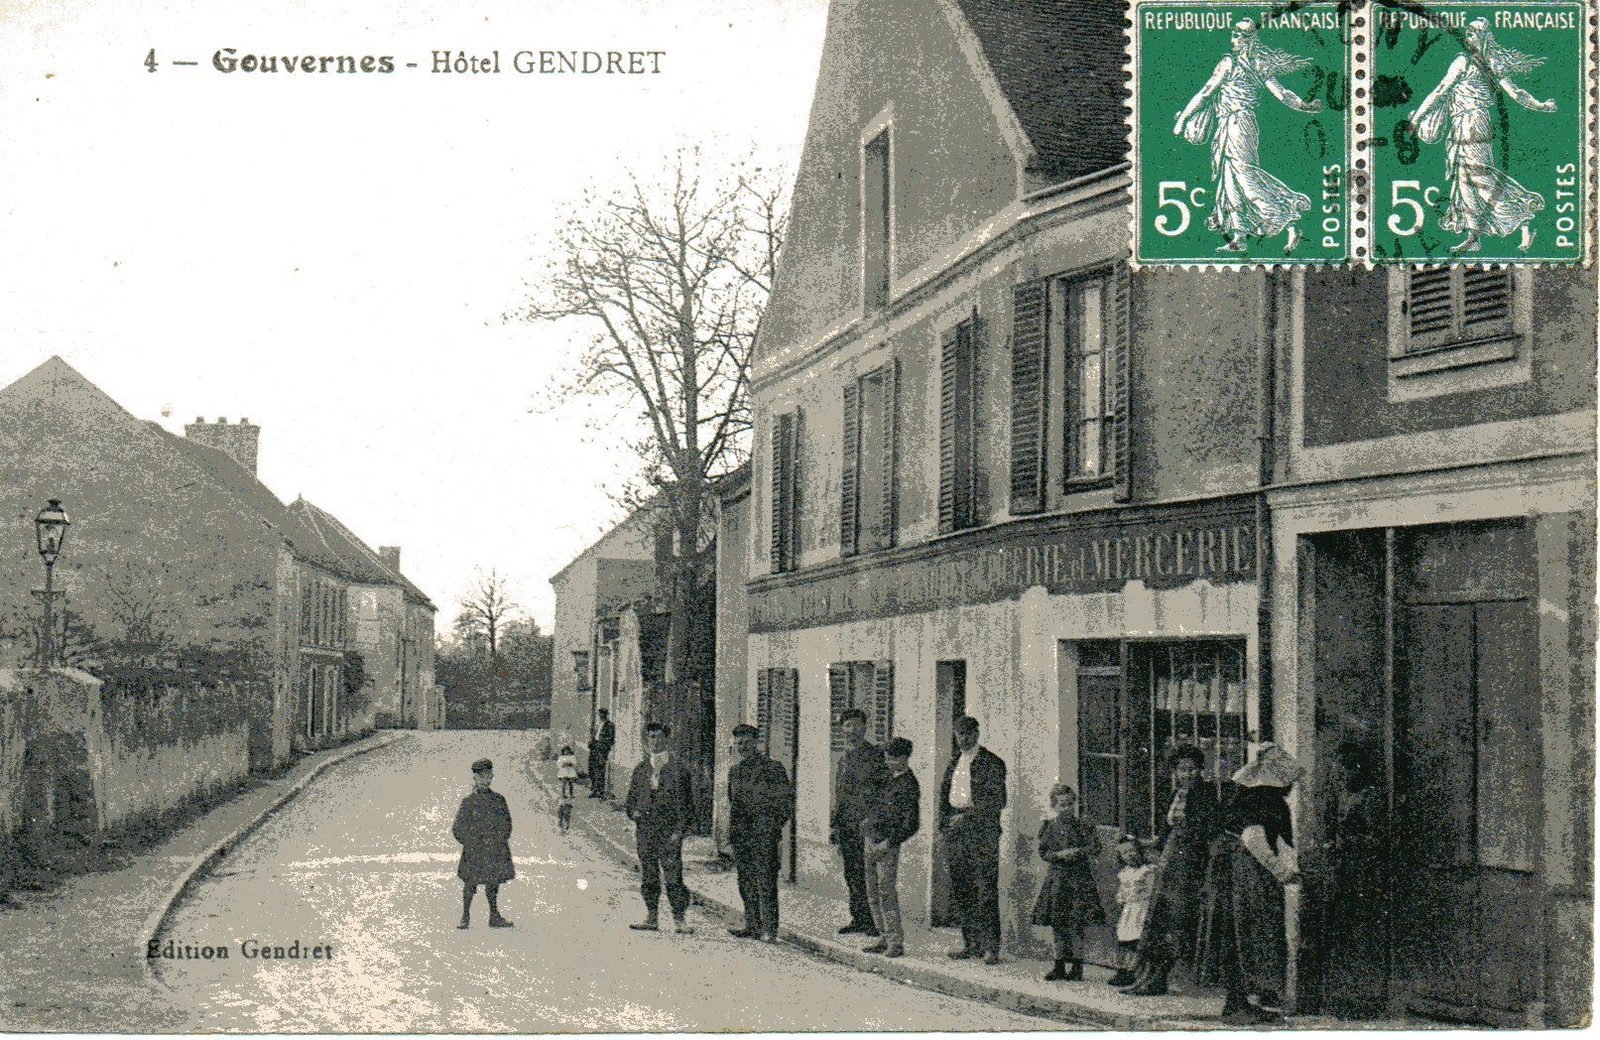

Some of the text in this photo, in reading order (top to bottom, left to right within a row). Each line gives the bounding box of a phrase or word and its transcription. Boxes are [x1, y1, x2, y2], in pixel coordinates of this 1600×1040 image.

[1494, 11, 1576, 32] FRANÇAISE
[1322, 164, 1341, 247] POSTES
[1556, 163, 1576, 248] POSTES
[1091, 525, 1251, 581] MERCERIE
